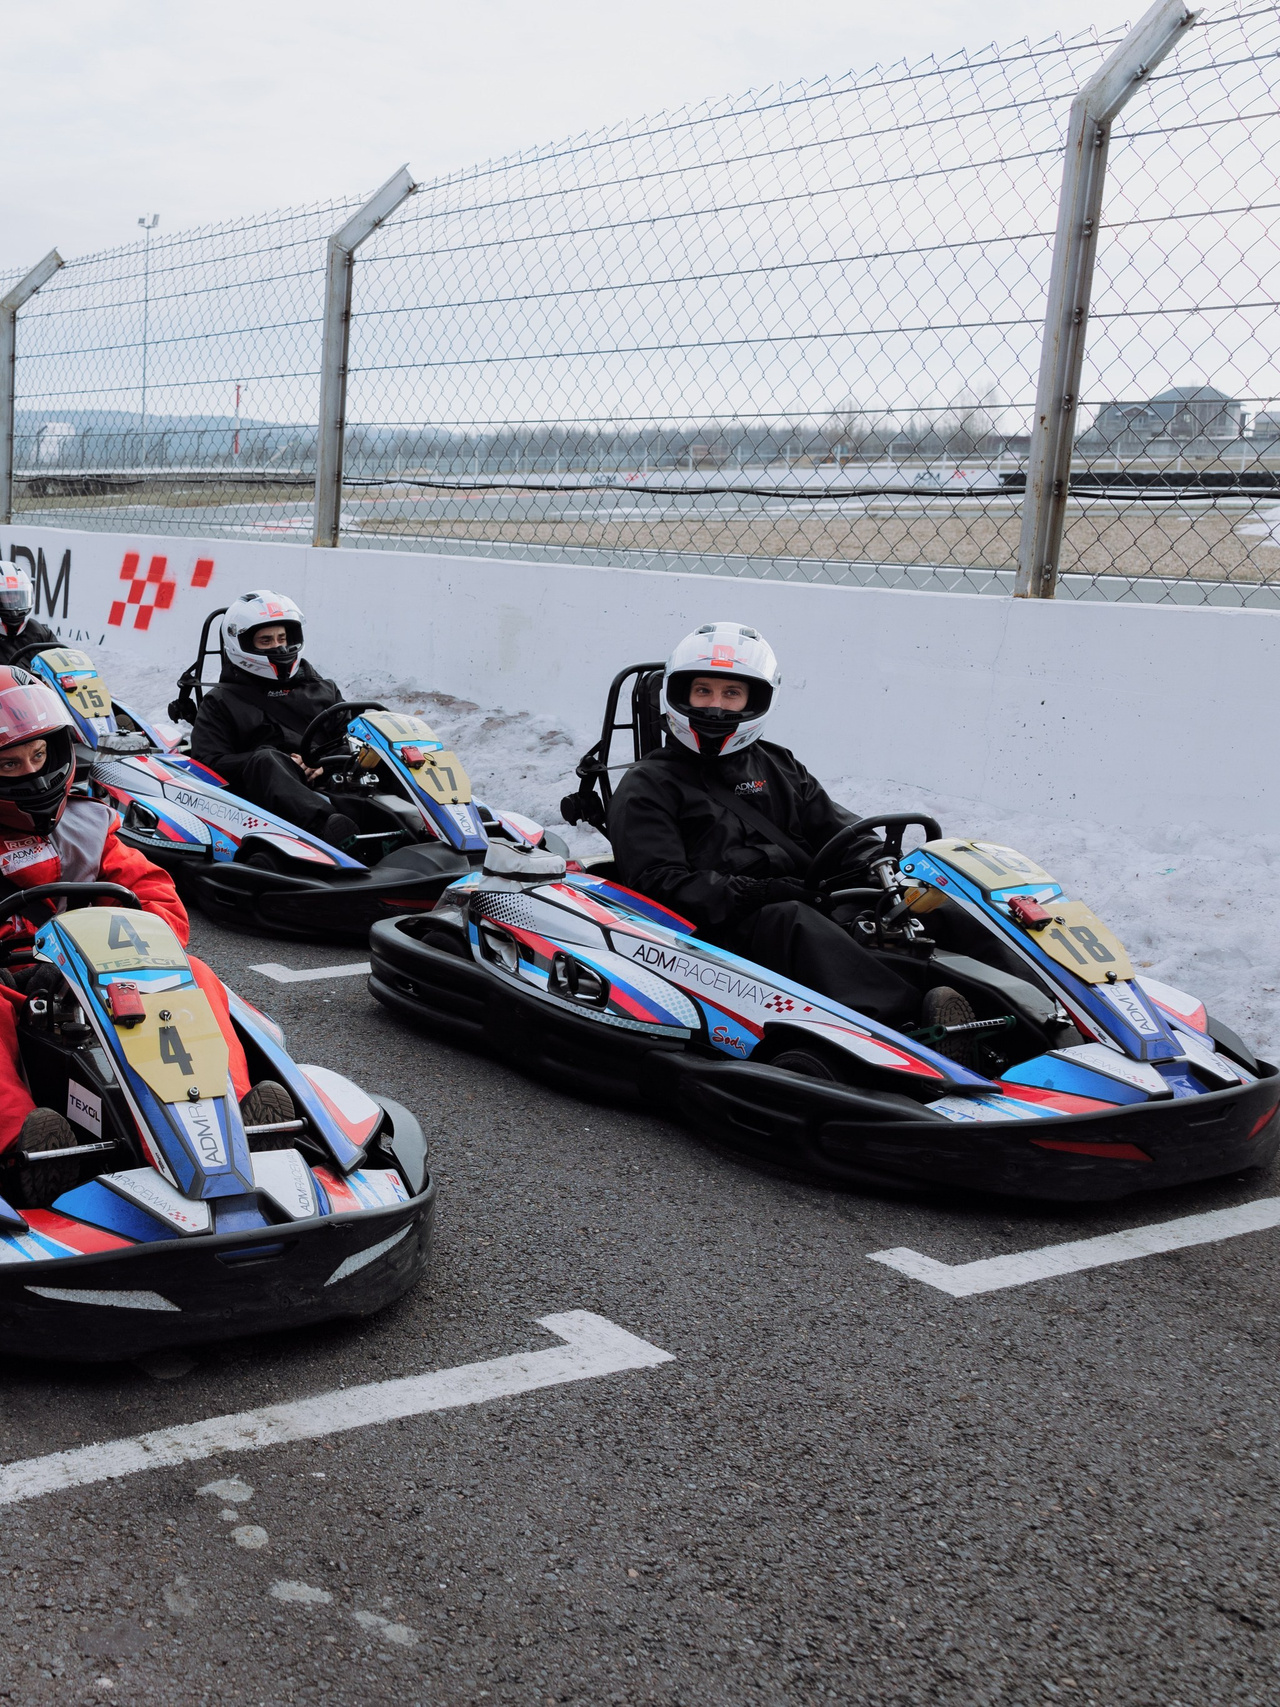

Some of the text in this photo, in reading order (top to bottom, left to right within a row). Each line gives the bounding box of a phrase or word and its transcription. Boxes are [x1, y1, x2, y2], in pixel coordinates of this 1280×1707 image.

[52, 650, 85, 667] 15
[76, 690, 105, 709] 15
[425, 766, 458, 792] 17
[735, 781, 756, 791] ADM
[175, 791, 247, 827] ADMRACEWAY
[13, 848, 34, 861] ADM
[107, 914, 151, 956] 4
[1048, 925, 1117, 966] 18
[632, 943, 773, 1006] ADMRACEWAY
[158, 1025, 195, 1077] 4
[711, 1025, 747, 1056] Sodi
[69, 1094, 101, 1123] TEXOL
[932, 1105, 983, 1122] RT
